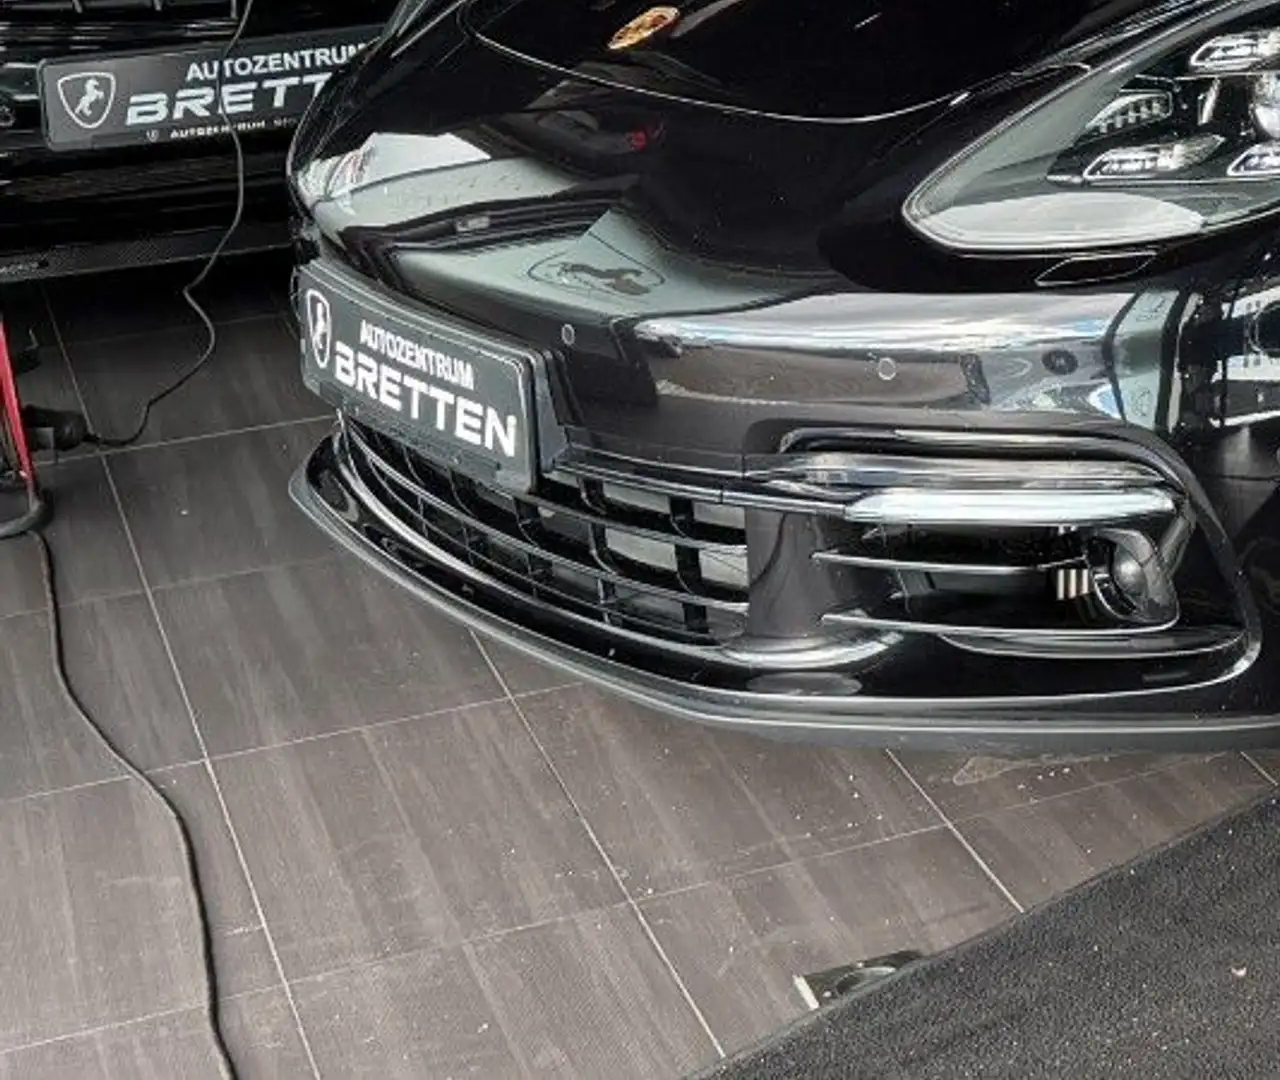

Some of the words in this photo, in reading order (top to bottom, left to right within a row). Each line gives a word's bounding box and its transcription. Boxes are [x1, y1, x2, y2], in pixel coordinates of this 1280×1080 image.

[126, 70, 334, 126] BRETT
[360, 320, 474, 390] AUTOZENTRUM
[335, 340, 517, 457] BRETTEN
